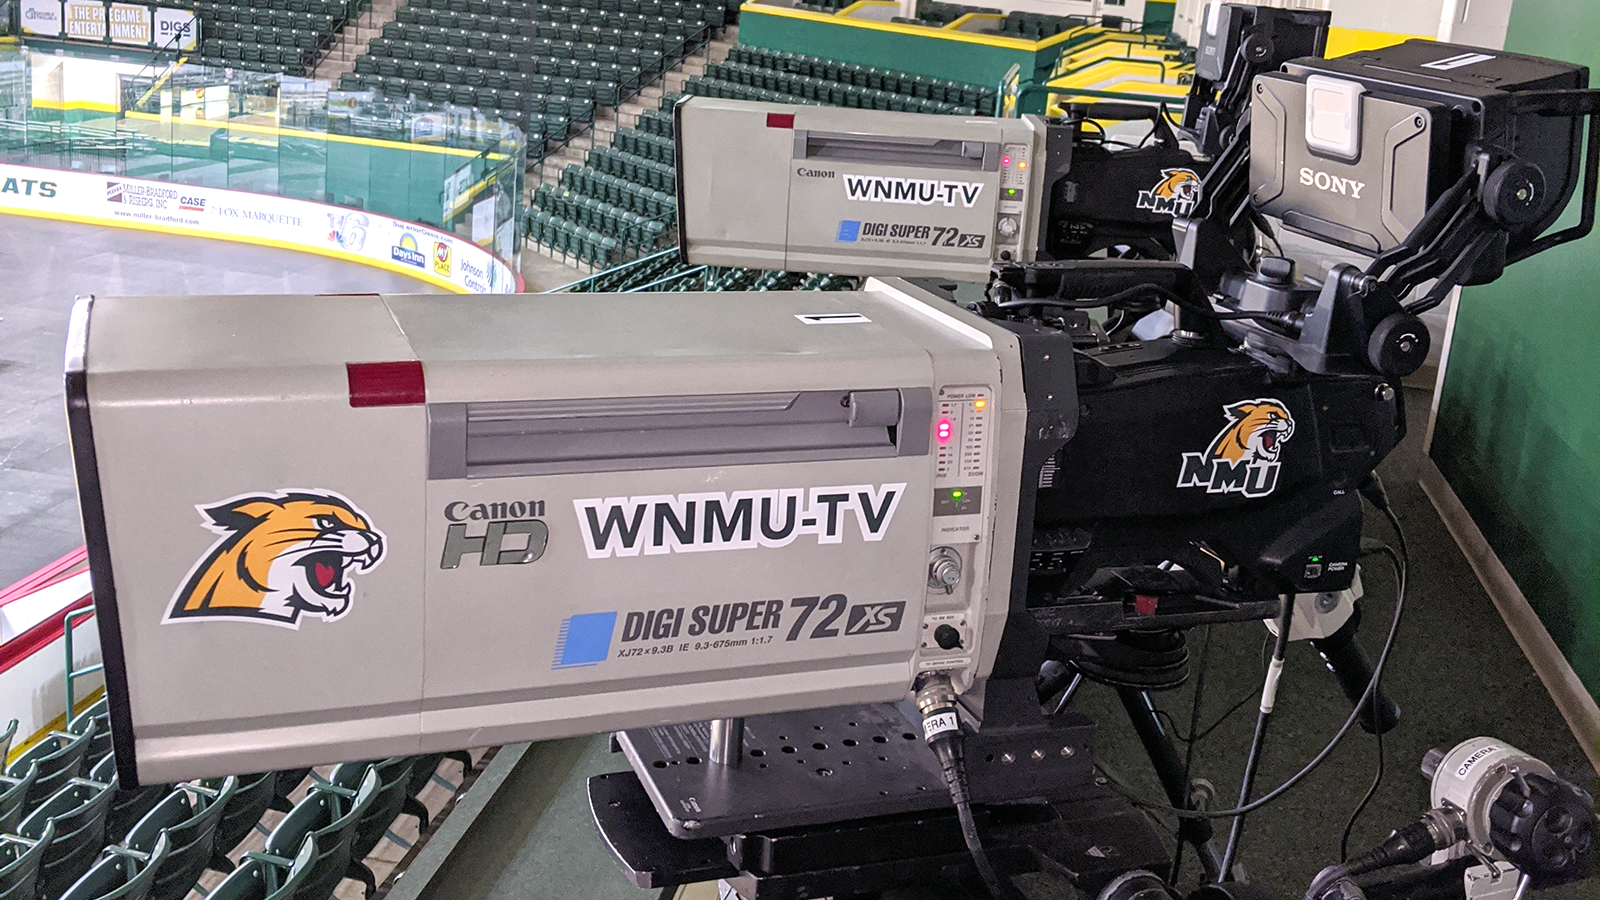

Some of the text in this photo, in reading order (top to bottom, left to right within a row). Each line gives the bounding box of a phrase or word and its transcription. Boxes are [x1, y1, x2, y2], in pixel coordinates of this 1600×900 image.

[74, 6, 90, 20] THE
[69, 20, 147, 38] ENTERTAINMENT
[161, 21, 191, 33] DIGS
[796, 167, 835, 179] Canon
[1, 177, 57, 198] ATS
[123, 183, 178, 200] MILLER-BRADFORD
[847, 177, 980, 205] WNMU-TV
[1299, 167, 1366, 199] SONY
[180, 196, 207, 207] CASE
[1136, 190, 1196, 218] NMU
[114, 210, 200, 226] www.miller-bradford.com
[242, 210, 304, 226] MARQUETTE
[862, 222, 888, 237] DIGI
[890, 224, 931, 240] SUPER
[931, 227, 960, 247] 72
[959, 234, 983, 248] XS
[393, 247, 412, 261] Days
[412, 253, 425, 264] Inn
[434, 260, 451, 273] PLACE
[461, 259, 484, 280] Johnson
[1176, 452, 1282, 498] NMU
[444, 498, 546, 522] Canon
[584, 490, 897, 551] WNMU-TV
[440, 519, 549, 570] HD
[621, 593, 902, 643] DIGI SUPER 72 XS
[694, 638, 748, 651] 9.3-675mm
[751, 635, 774, 645] 1:1.7
[948, 716, 955, 726] 1
[1458, 747, 1497, 776] CAMERA
